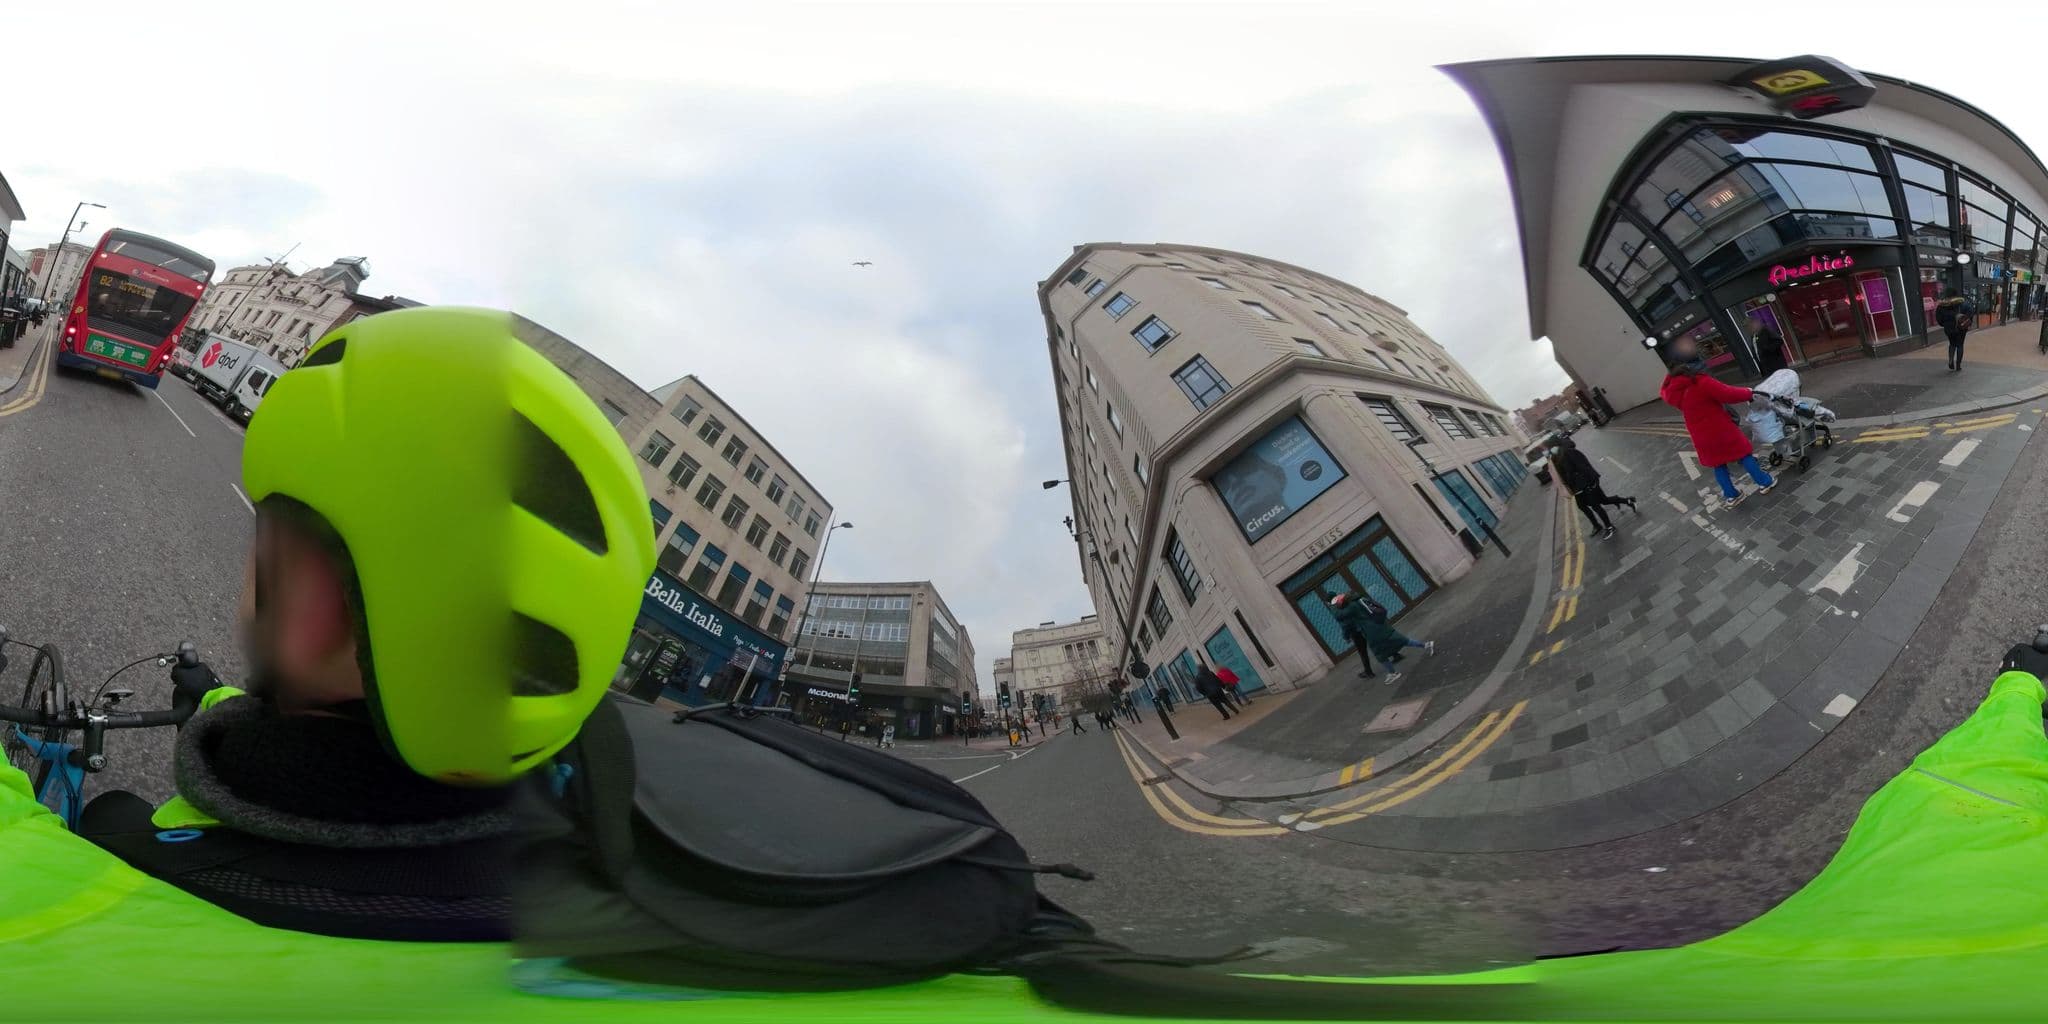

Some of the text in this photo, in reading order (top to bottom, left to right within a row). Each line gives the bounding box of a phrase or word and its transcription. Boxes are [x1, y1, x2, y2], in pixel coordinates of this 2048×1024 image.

[1768, 250, 1855, 287] Archie's
[218, 352, 240, 369] dpd
[644, 576, 724, 637] Bella Italia
